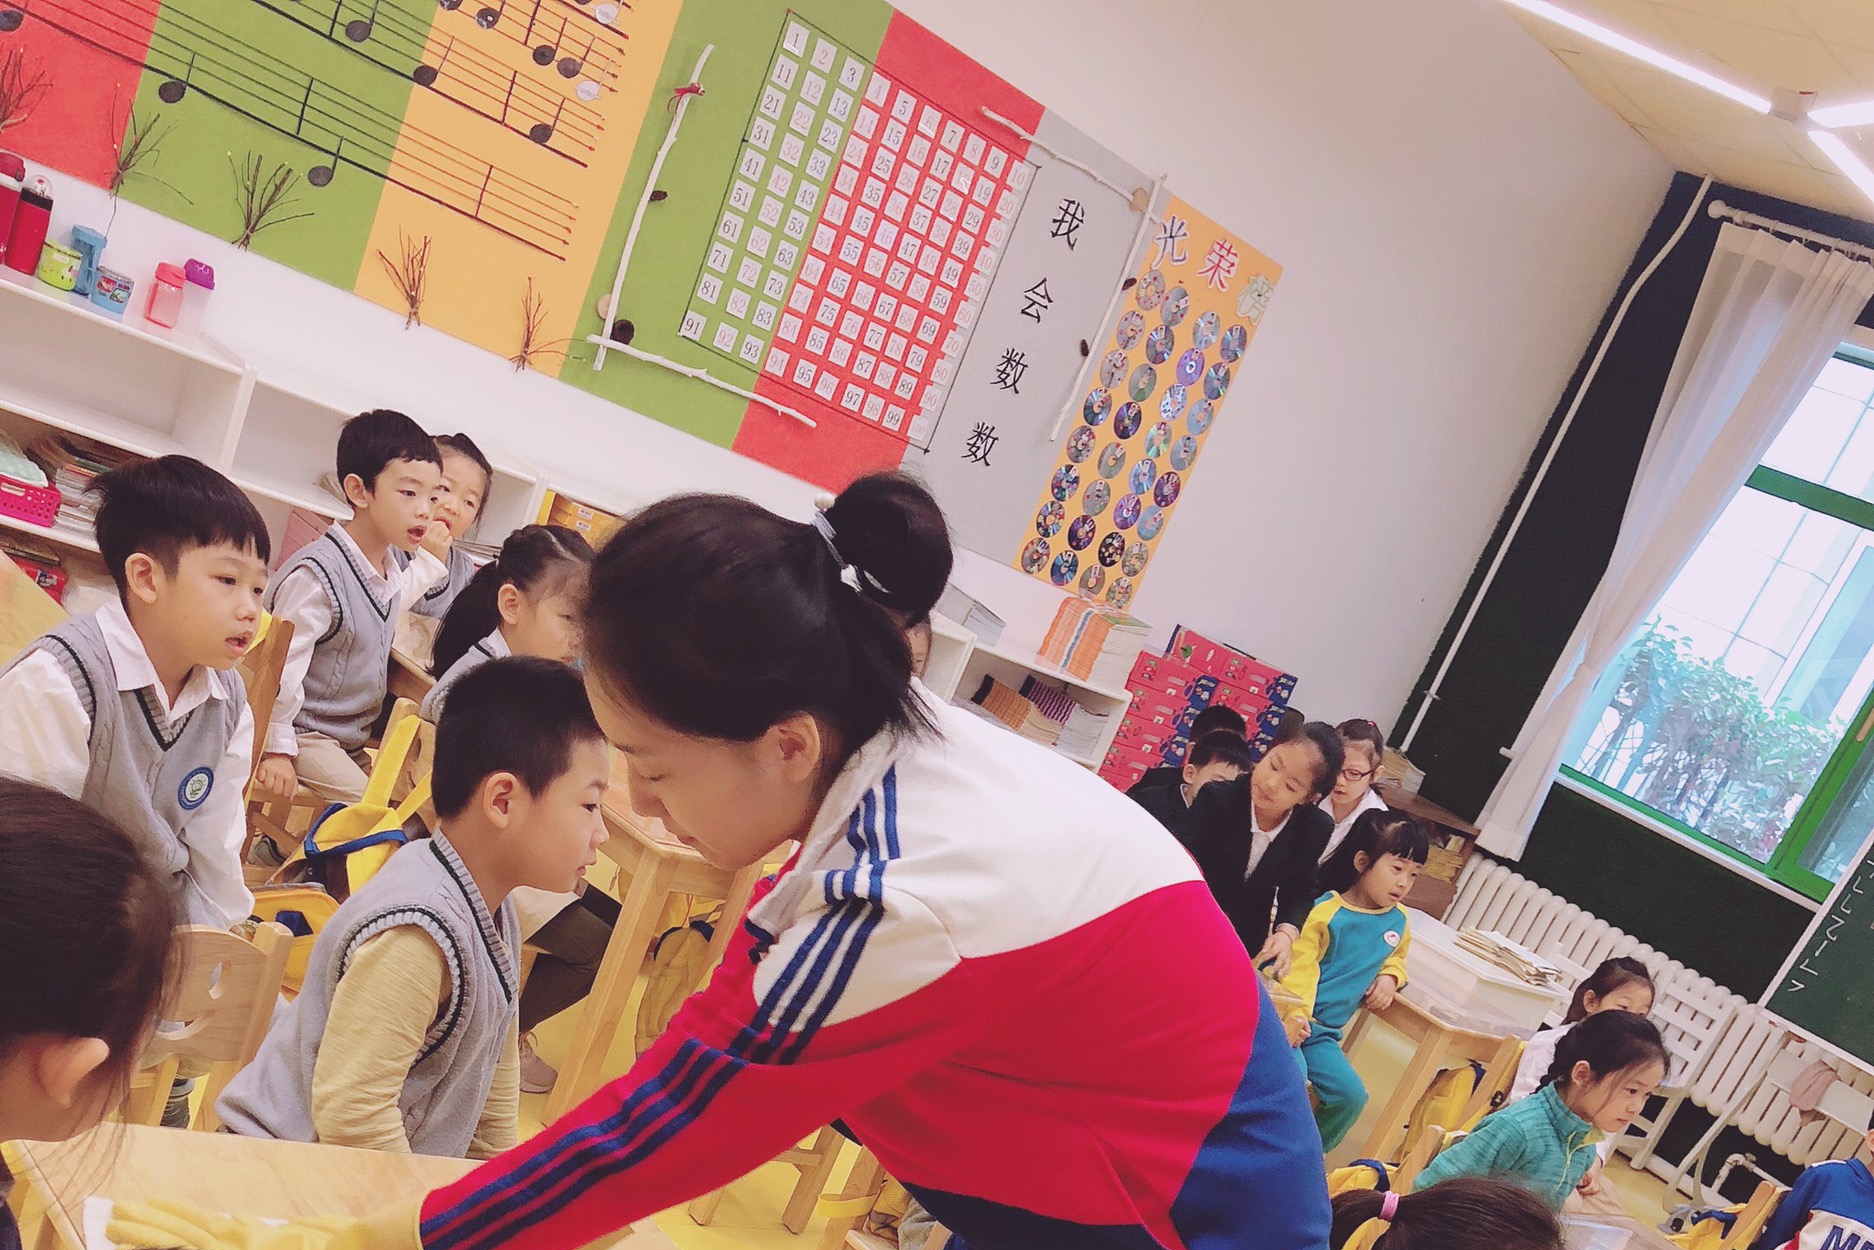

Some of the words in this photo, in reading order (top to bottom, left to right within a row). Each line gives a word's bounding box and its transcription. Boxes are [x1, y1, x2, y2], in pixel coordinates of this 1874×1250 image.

[753, 126, 769, 144] 31
[809, 156, 826, 176] 33
[865, 184, 882, 203] 35
[912, 212, 928, 229] 37
[955, 237, 970, 255] 39
[763, 96, 780, 114] 21
[821, 126, 838, 146] 23
[875, 155, 892, 174] 25
[922, 185, 939, 203] 27
[965, 211, 980, 228] 29
[777, 64, 792, 84] 11
[833, 97, 848, 117] 13
[886, 127, 902, 146] 15
[934, 157, 950, 175] 17
[977, 184, 991, 201] 19
[722, 221, 738, 238] 61
[777, 248, 794, 266] 63
[831, 276, 847, 293] 65
[878, 300, 894, 316] 67
[922, 321, 937, 337] 69
[733, 187, 749, 207] 51
[788, 216, 804, 235] 53
[843, 242, 860, 260] 55
[891, 267, 906, 284] 57
[935, 292, 948, 309] 59
[744, 157, 759, 175] 41
[800, 189, 815, 206] 43
[856, 215, 871, 231] 45
[903, 241, 917, 258] 47
[945, 266, 959, 282] 49
[1152, 215, 1275, 323] 光荣榜
[701, 280, 717, 299] 81
[756, 308, 772, 325] 83
[808, 332, 825, 350] 85
[856, 358, 873, 373] 87
[898, 379, 913, 395] 89
[712, 249, 727, 268] 71
[768, 277, 784, 295] 73
[820, 304, 836, 322] 75
[868, 328, 883, 345] 77
[910, 350, 924, 367] 79
[962, 198, 1085, 467] 我会数数
[684, 317, 700, 335] 91
[743, 341, 760, 359] 93
[798, 366, 813, 383] 95
[845, 390, 861, 406] 97
[887, 411, 901, 426] 99
